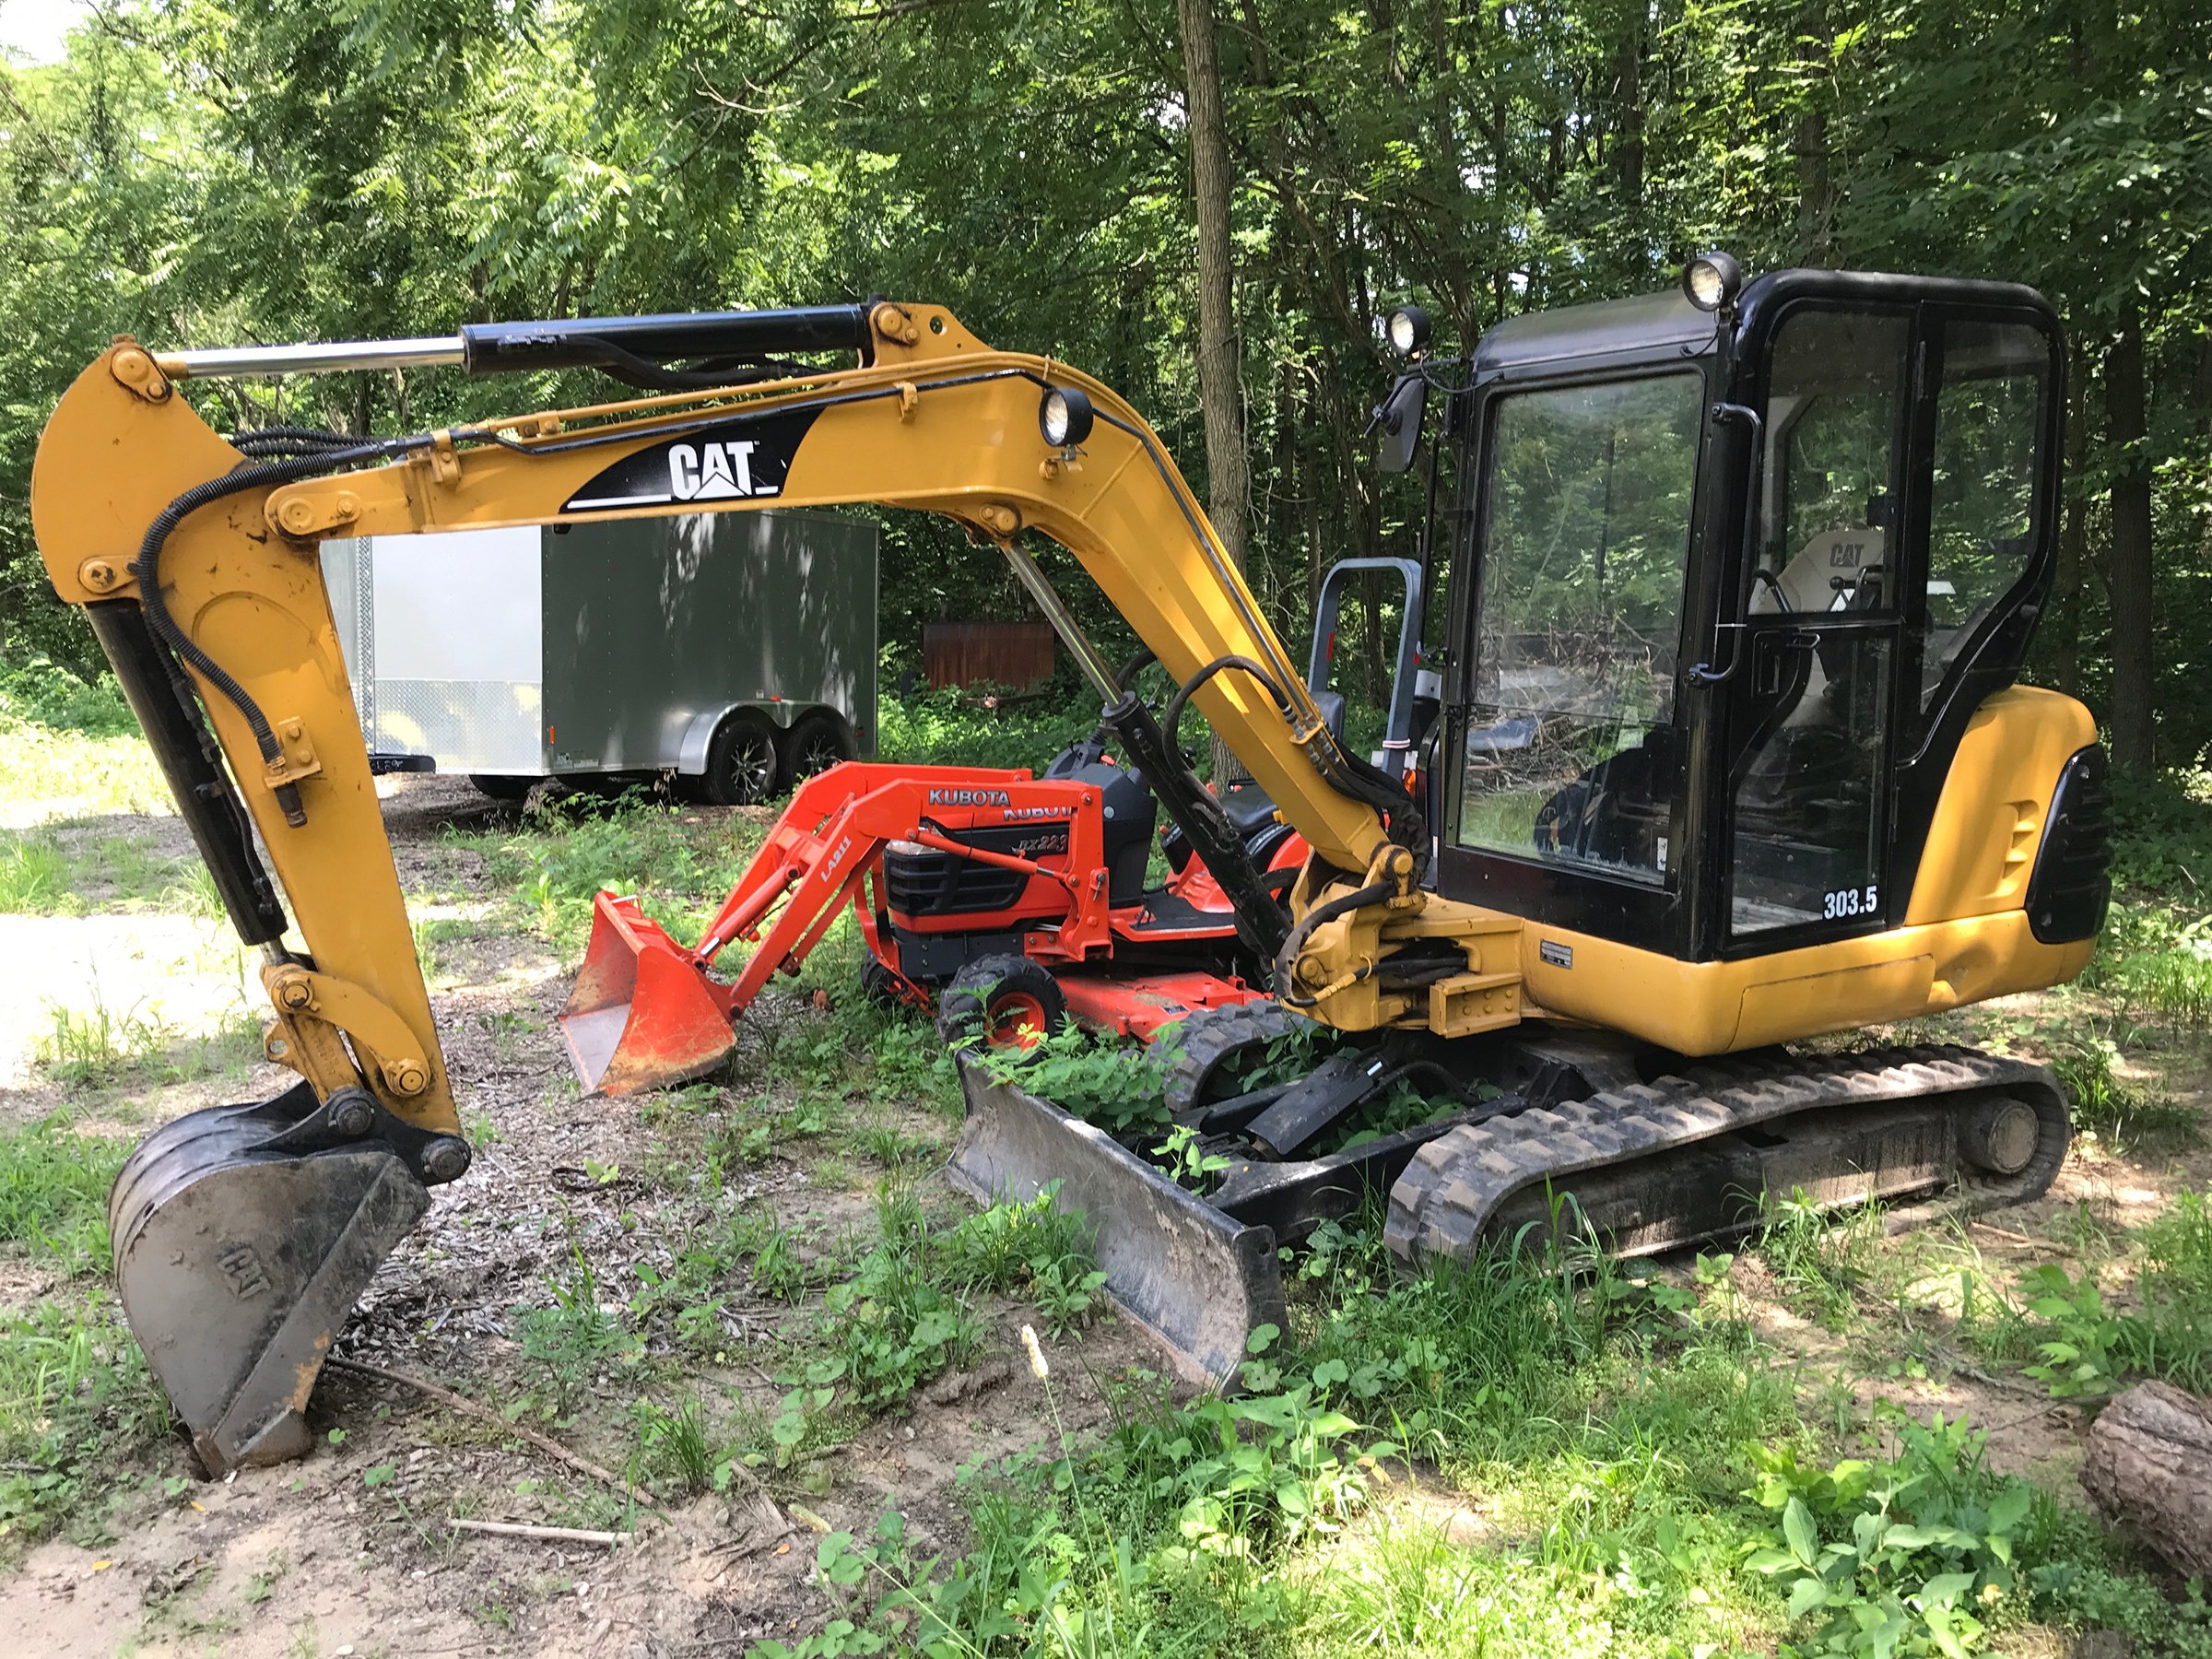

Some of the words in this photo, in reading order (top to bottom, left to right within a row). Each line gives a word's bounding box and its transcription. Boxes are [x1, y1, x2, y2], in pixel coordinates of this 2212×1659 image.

[668, 441, 755, 500] CAT
[1830, 544, 1865, 569] CAT
[928, 789, 1011, 806] KUBOTA
[1004, 806, 1072, 821] KUBOT
[820, 835, 852, 882] LA211
[1824, 885, 1877, 920] 303.5
[217, 1247, 271, 1300] CAT
